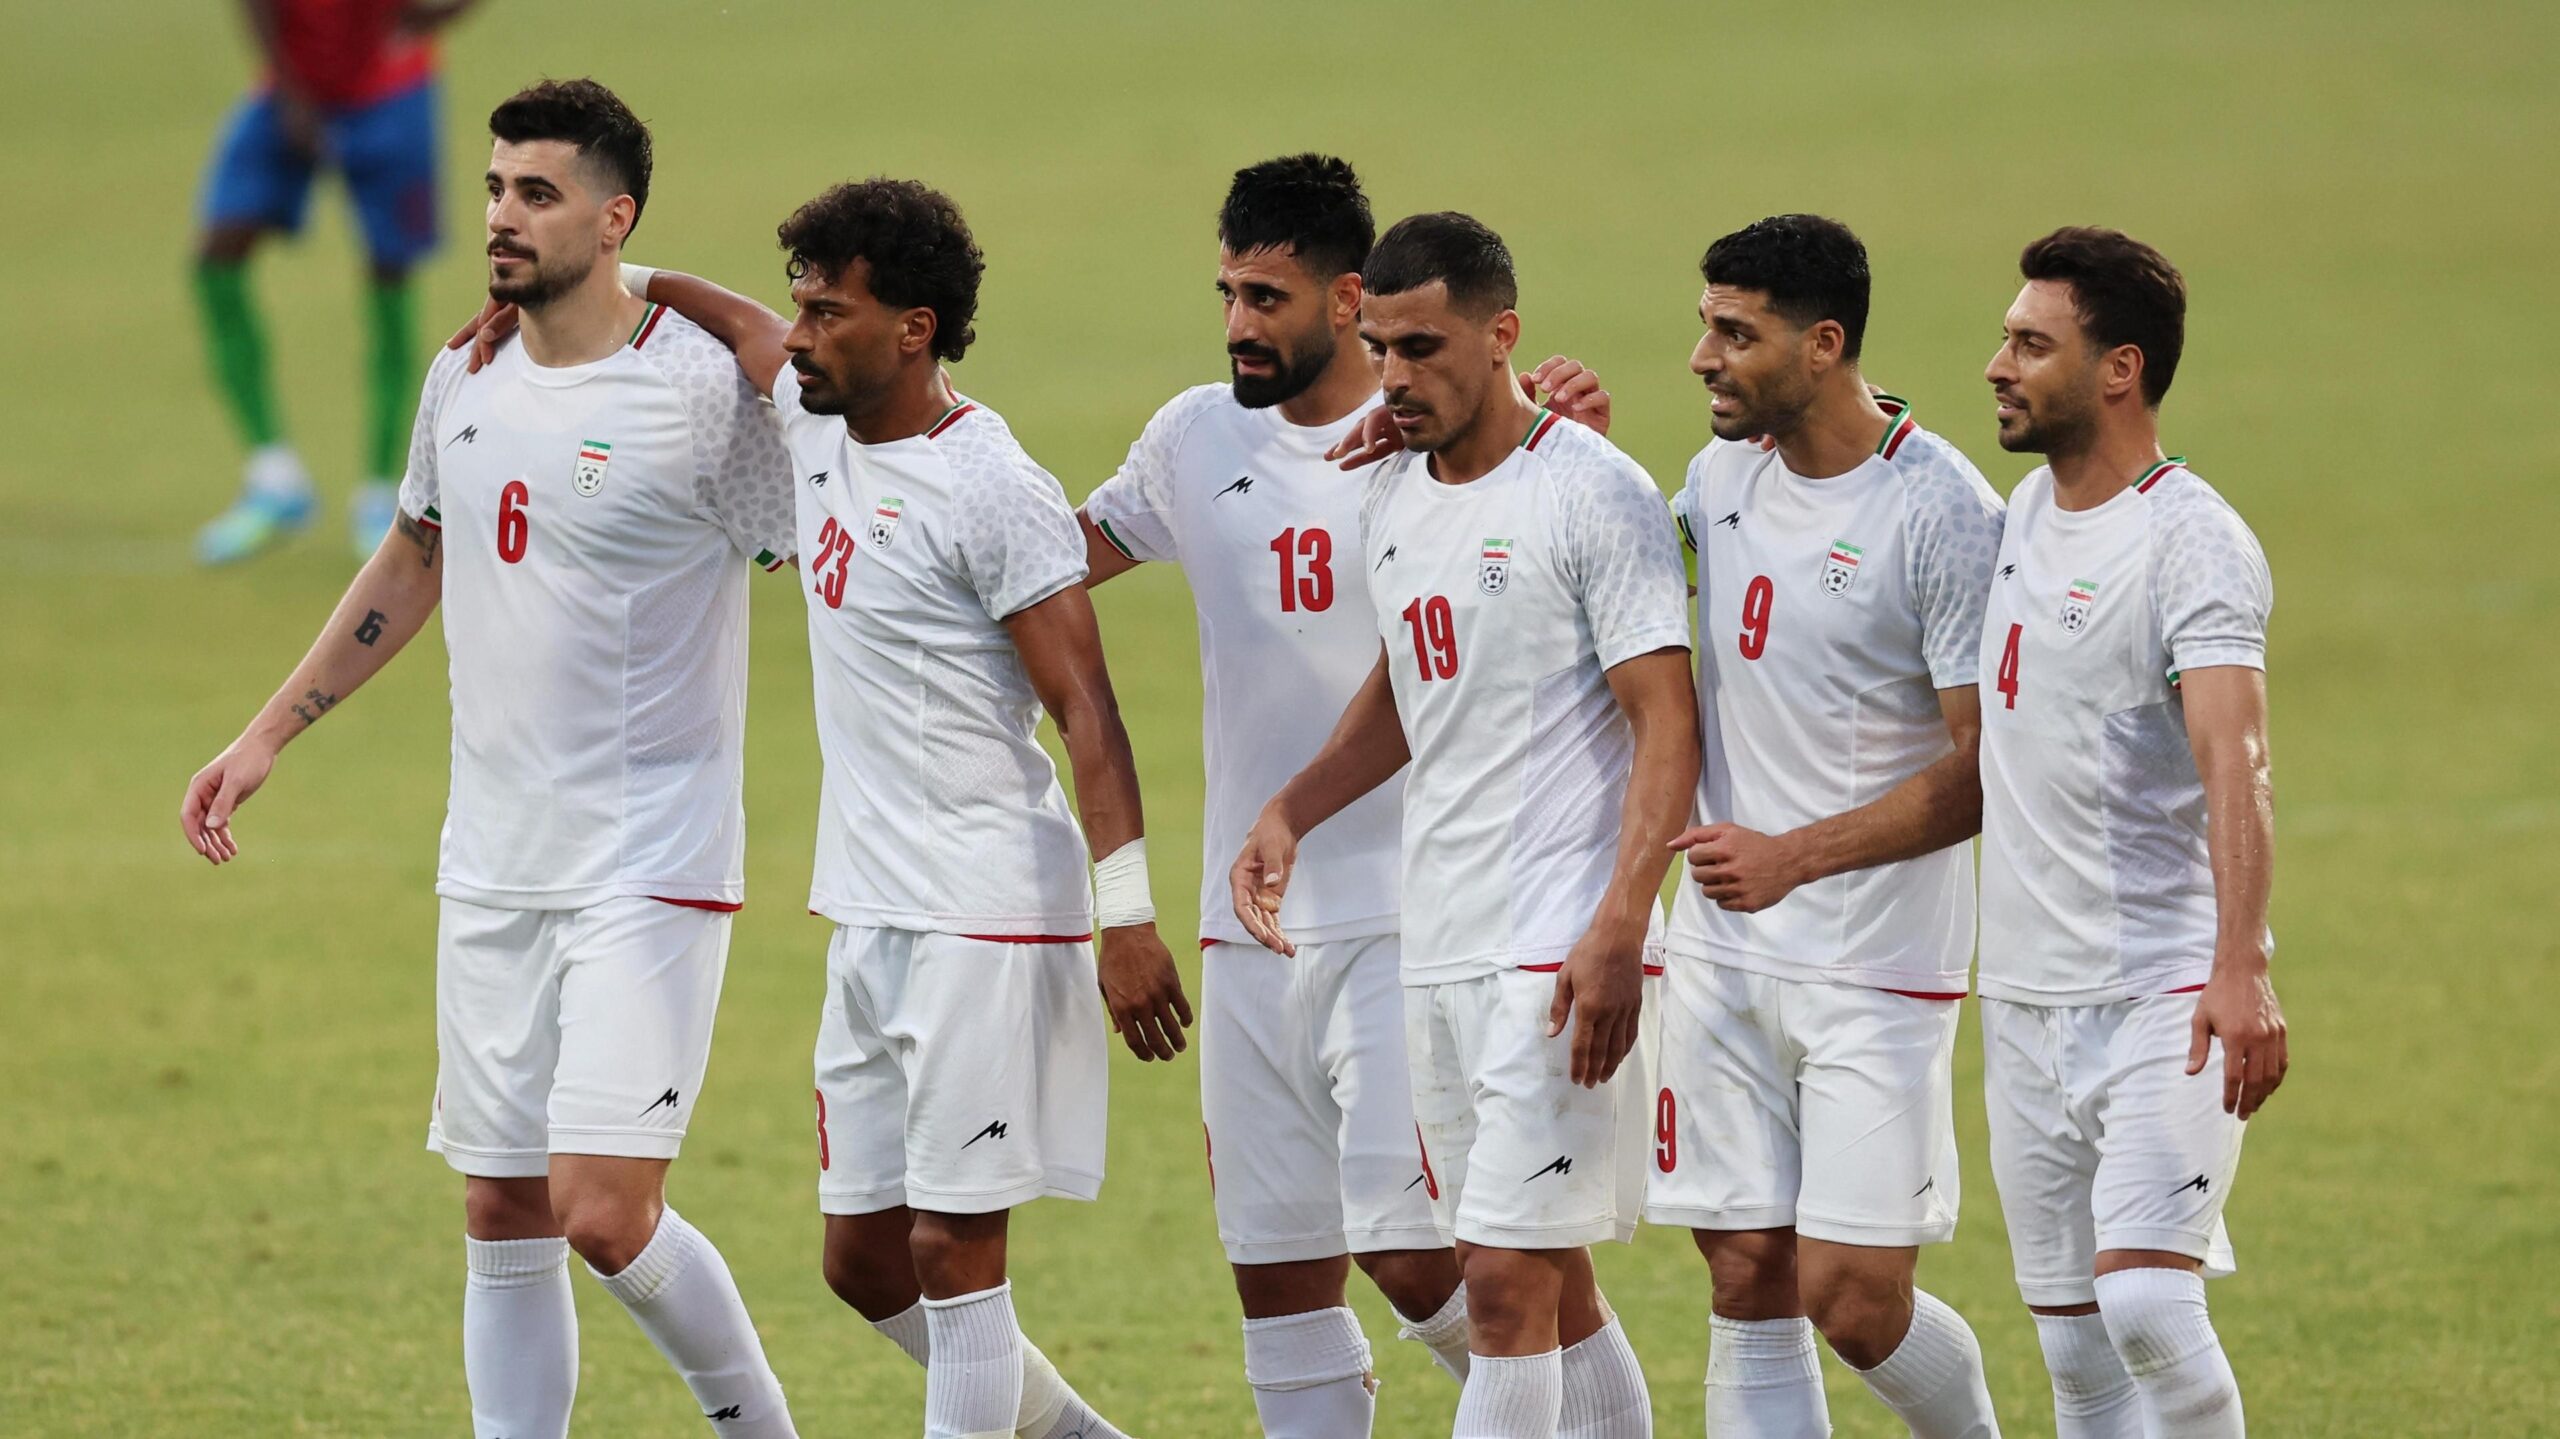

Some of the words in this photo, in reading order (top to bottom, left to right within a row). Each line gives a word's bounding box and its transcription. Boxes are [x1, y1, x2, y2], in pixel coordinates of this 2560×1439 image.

[497, 479, 529, 564] 6
[812, 516, 855, 610] 23
[1270, 526, 1335, 612] 13
[1402, 595, 1459, 682] 19
[1738, 574, 1774, 661] 9
[1997, 623, 2023, 710] 4
[1657, 1086, 1678, 1173] 9
